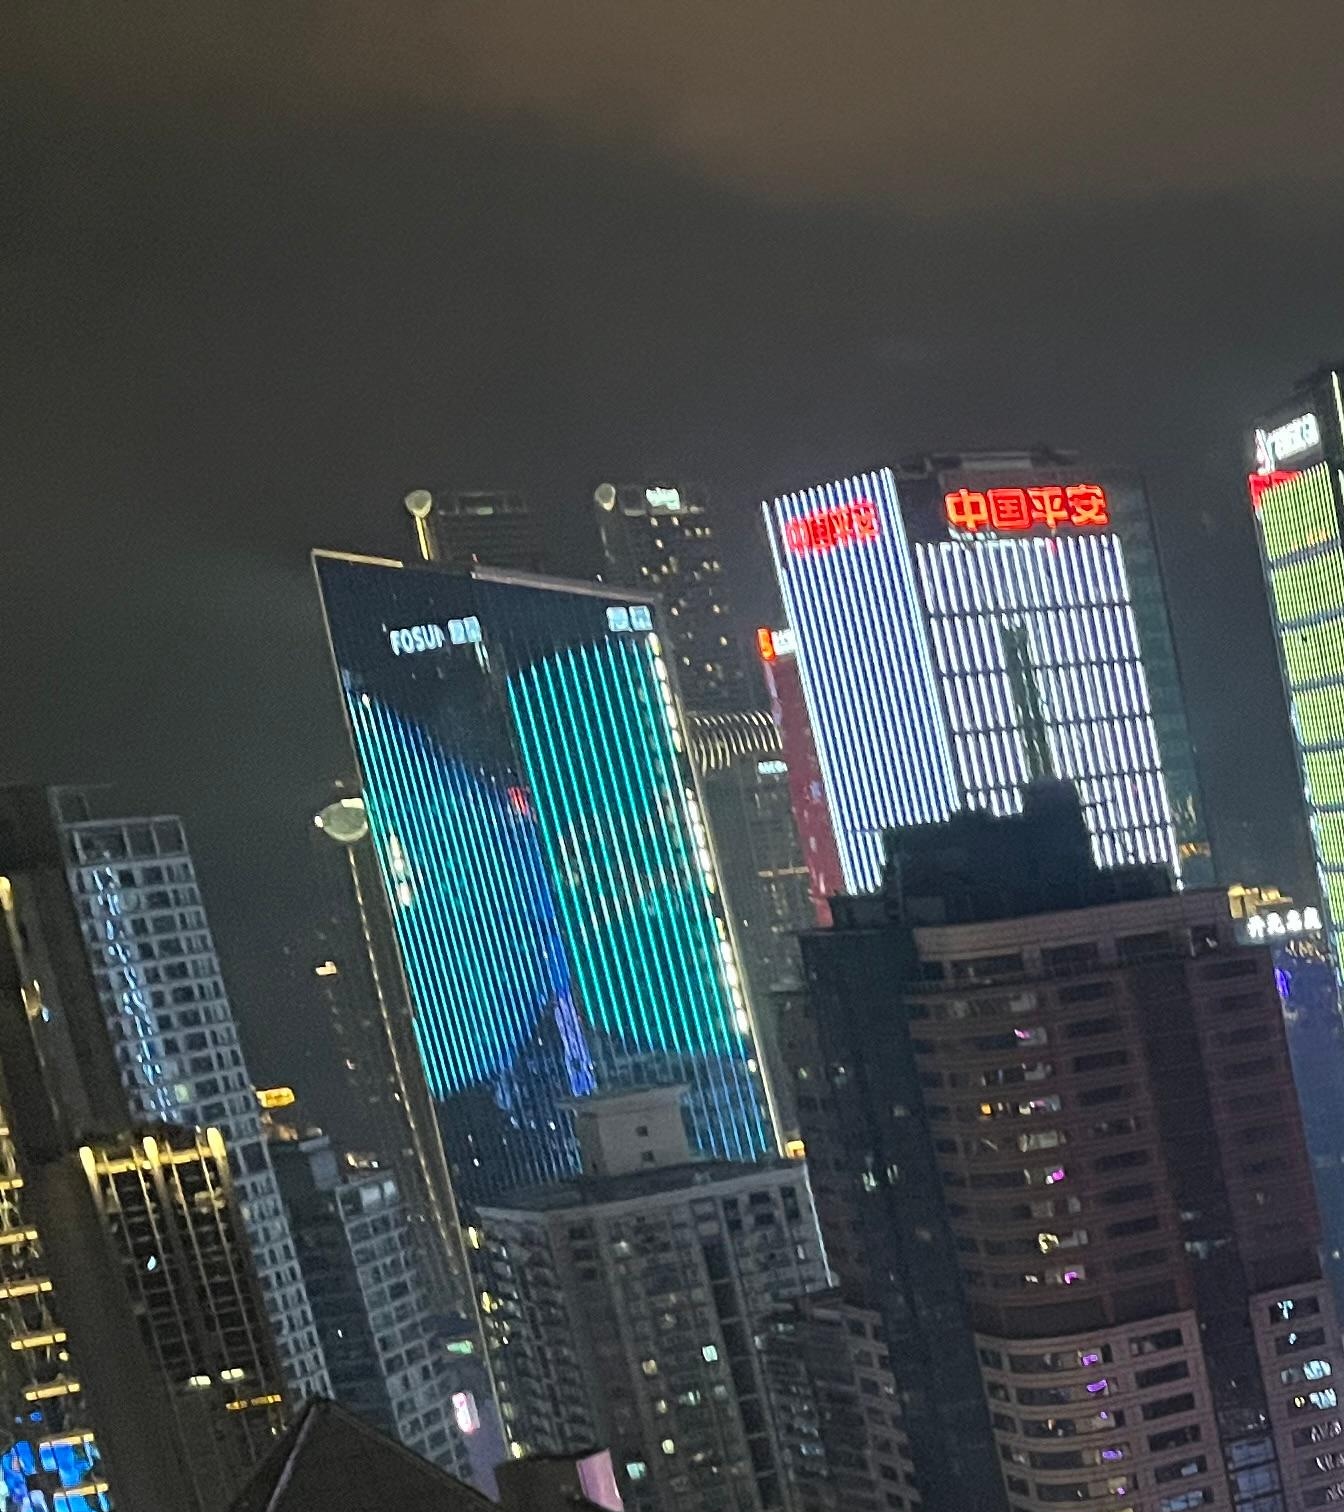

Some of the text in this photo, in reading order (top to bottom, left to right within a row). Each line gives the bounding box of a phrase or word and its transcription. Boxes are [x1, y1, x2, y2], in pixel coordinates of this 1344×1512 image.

[785, 498, 880, 557] 中国平安
[945, 484, 1108, 532] 中国平安
